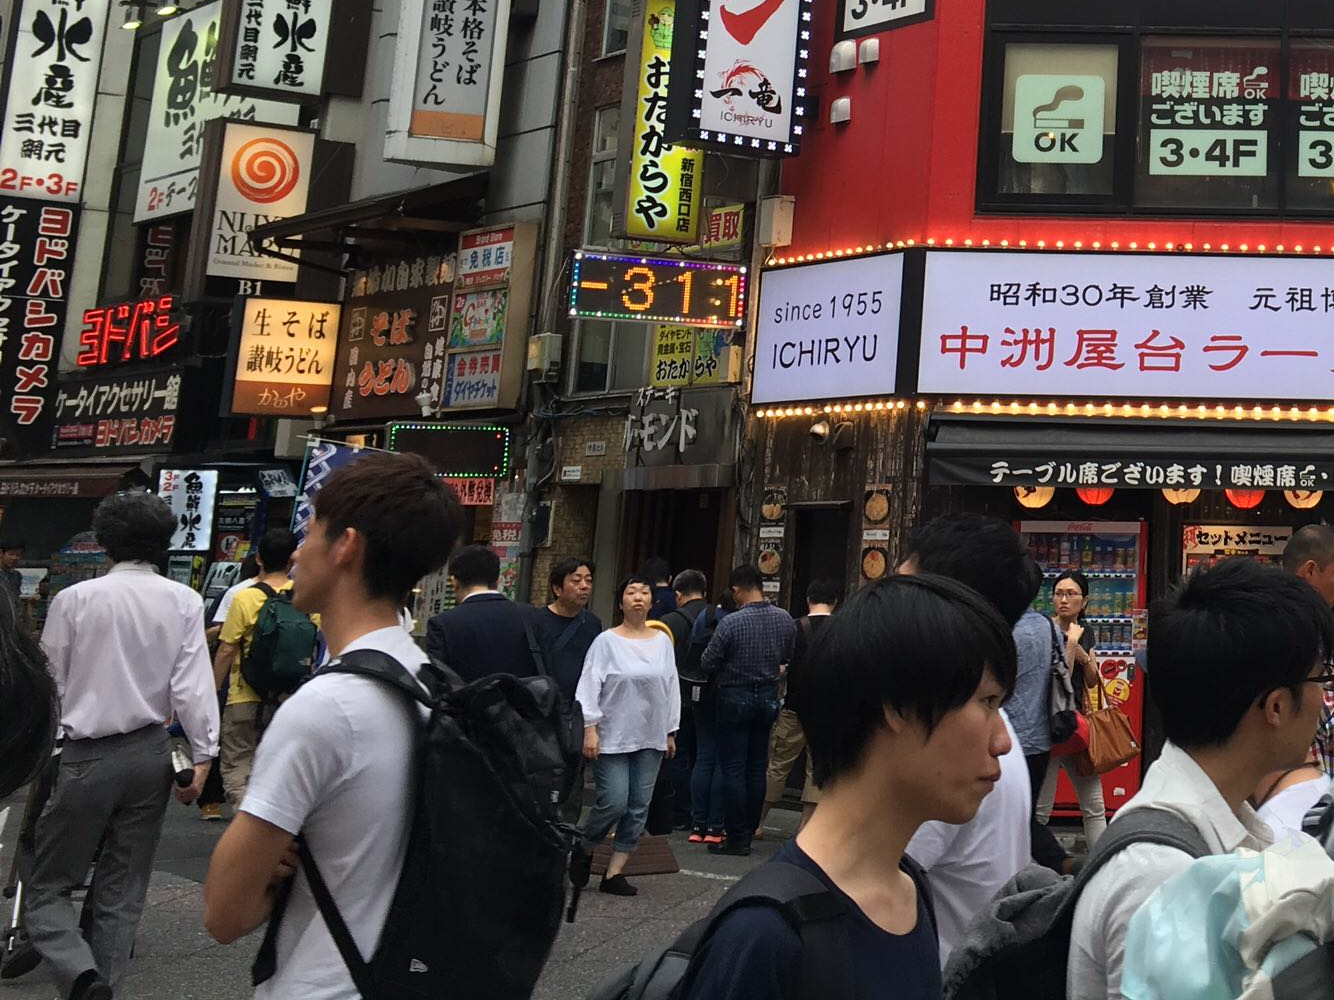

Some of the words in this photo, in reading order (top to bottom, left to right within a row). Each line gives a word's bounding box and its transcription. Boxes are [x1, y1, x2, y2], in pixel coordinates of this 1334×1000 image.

[1151, 70, 1240, 100] 喫煙席
[1243, 88, 1267, 100] OK
[13, 112, 81, 139] 三代目
[719, 110, 773, 128] ICHIRYU
[1150, 101, 1268, 126] ございます
[20, 138, 66, 163] 網元
[1034, 132, 1080, 153] OK
[676, 157, 695, 233] 新宿西口店
[703, 210, 740, 243] 買取
[469, 246, 505, 270] 免税店
[238, 280, 263, 296] B1
[989, 282, 1214, 310] 昭和30年創業
[10, 206, 73, 425] ヨドバシカメラ
[773, 304, 822, 324] since
[829, 291, 883, 319] 1955
[77, 296, 181, 368] ヨドバシ
[252, 308, 330, 339] 生そば
[369, 308, 416, 347] そば
[659, 328, 692, 341] ダイヤモンド
[246, 344, 323, 375] 讃岐うどん
[772, 334, 878, 370] ICHIRYU
[358, 357, 411, 397] うどん
[656, 356, 717, 381] おたからや
[55, 374, 181, 418] ケータイアクセサリー館
[95, 415, 176, 448] ヨドバシカメラ
[163, 482, 179, 492] 2F
[164, 471, 180, 481] 3F
[1196, 530, 1289, 547] セットメニュー
